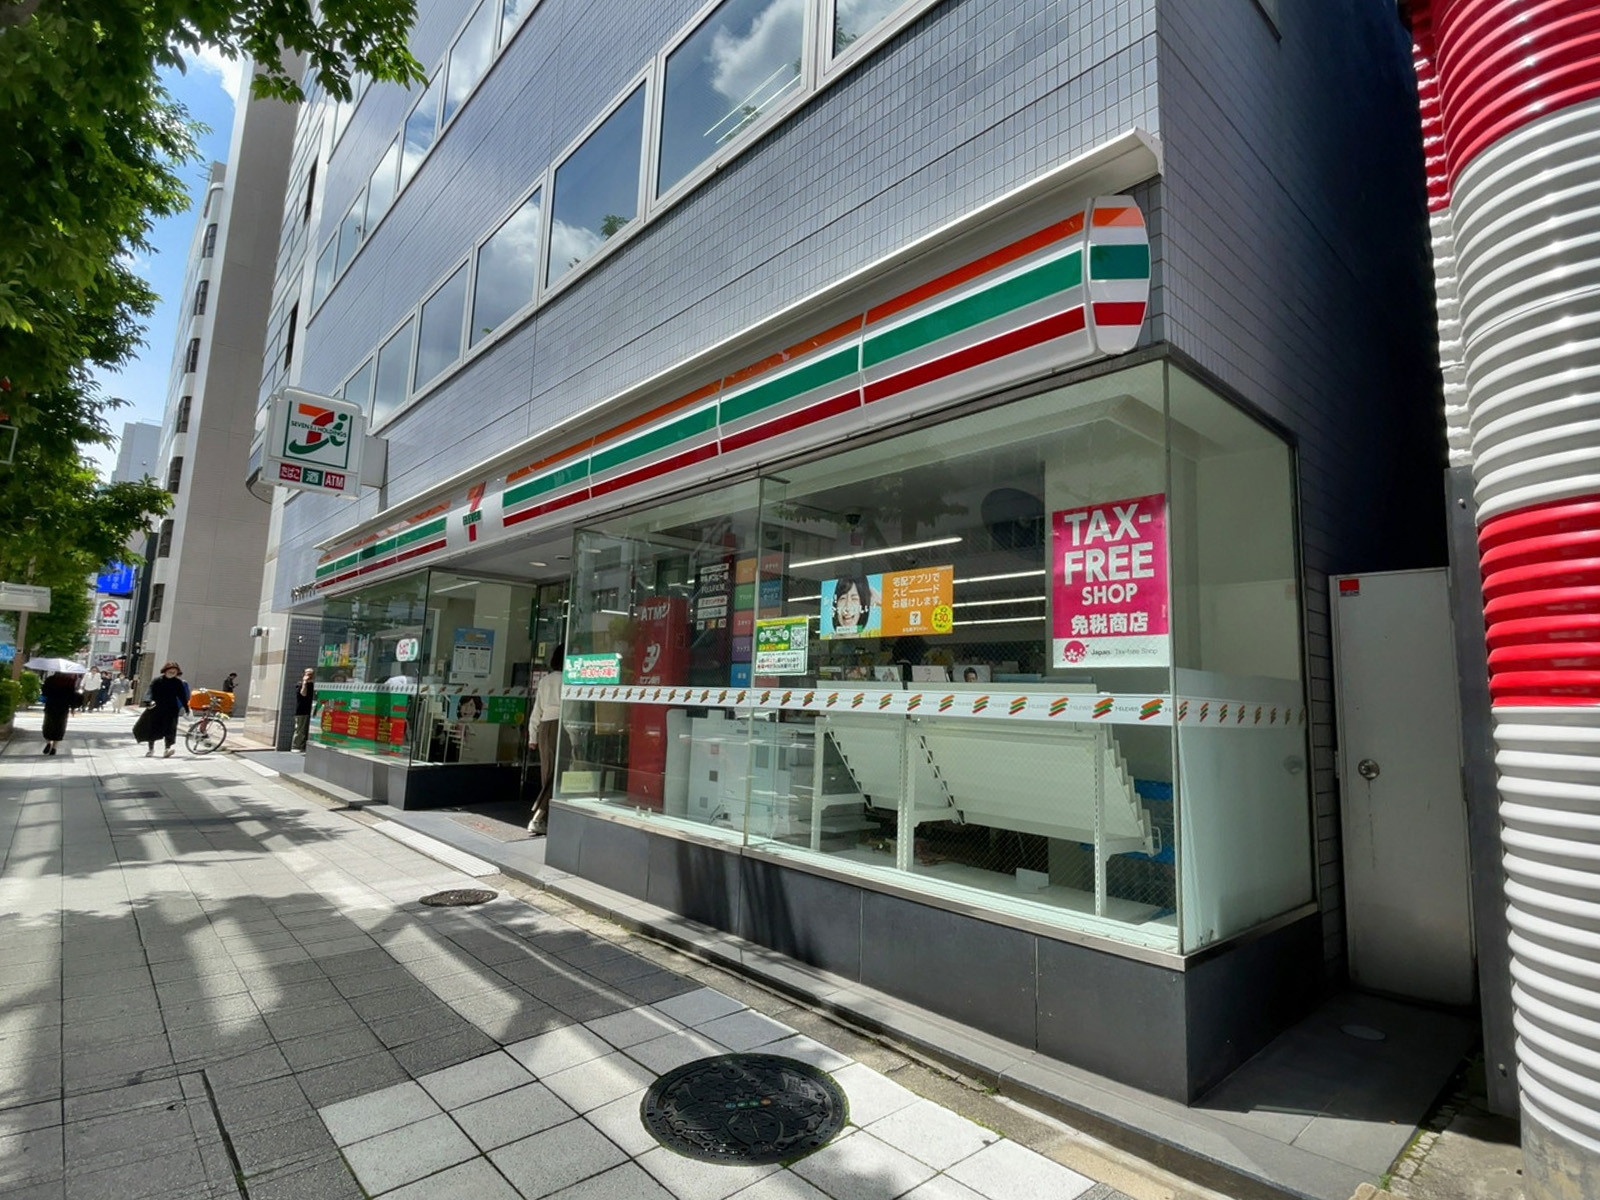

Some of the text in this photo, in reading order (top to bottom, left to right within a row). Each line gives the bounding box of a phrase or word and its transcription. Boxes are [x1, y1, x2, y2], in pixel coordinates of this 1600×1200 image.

[326, 473, 345, 487] ATM
[1064, 503, 1153, 546] TAX-
[1064, 541, 1155, 585] FREE
[892, 572, 940, 587] 宅配アプリで
[1081, 583, 1138, 606] SHOP
[640, 606, 662, 621] ATM
[1071, 611, 1149, 635] 免税商店
[1141, 646, 1158, 656] Shop
